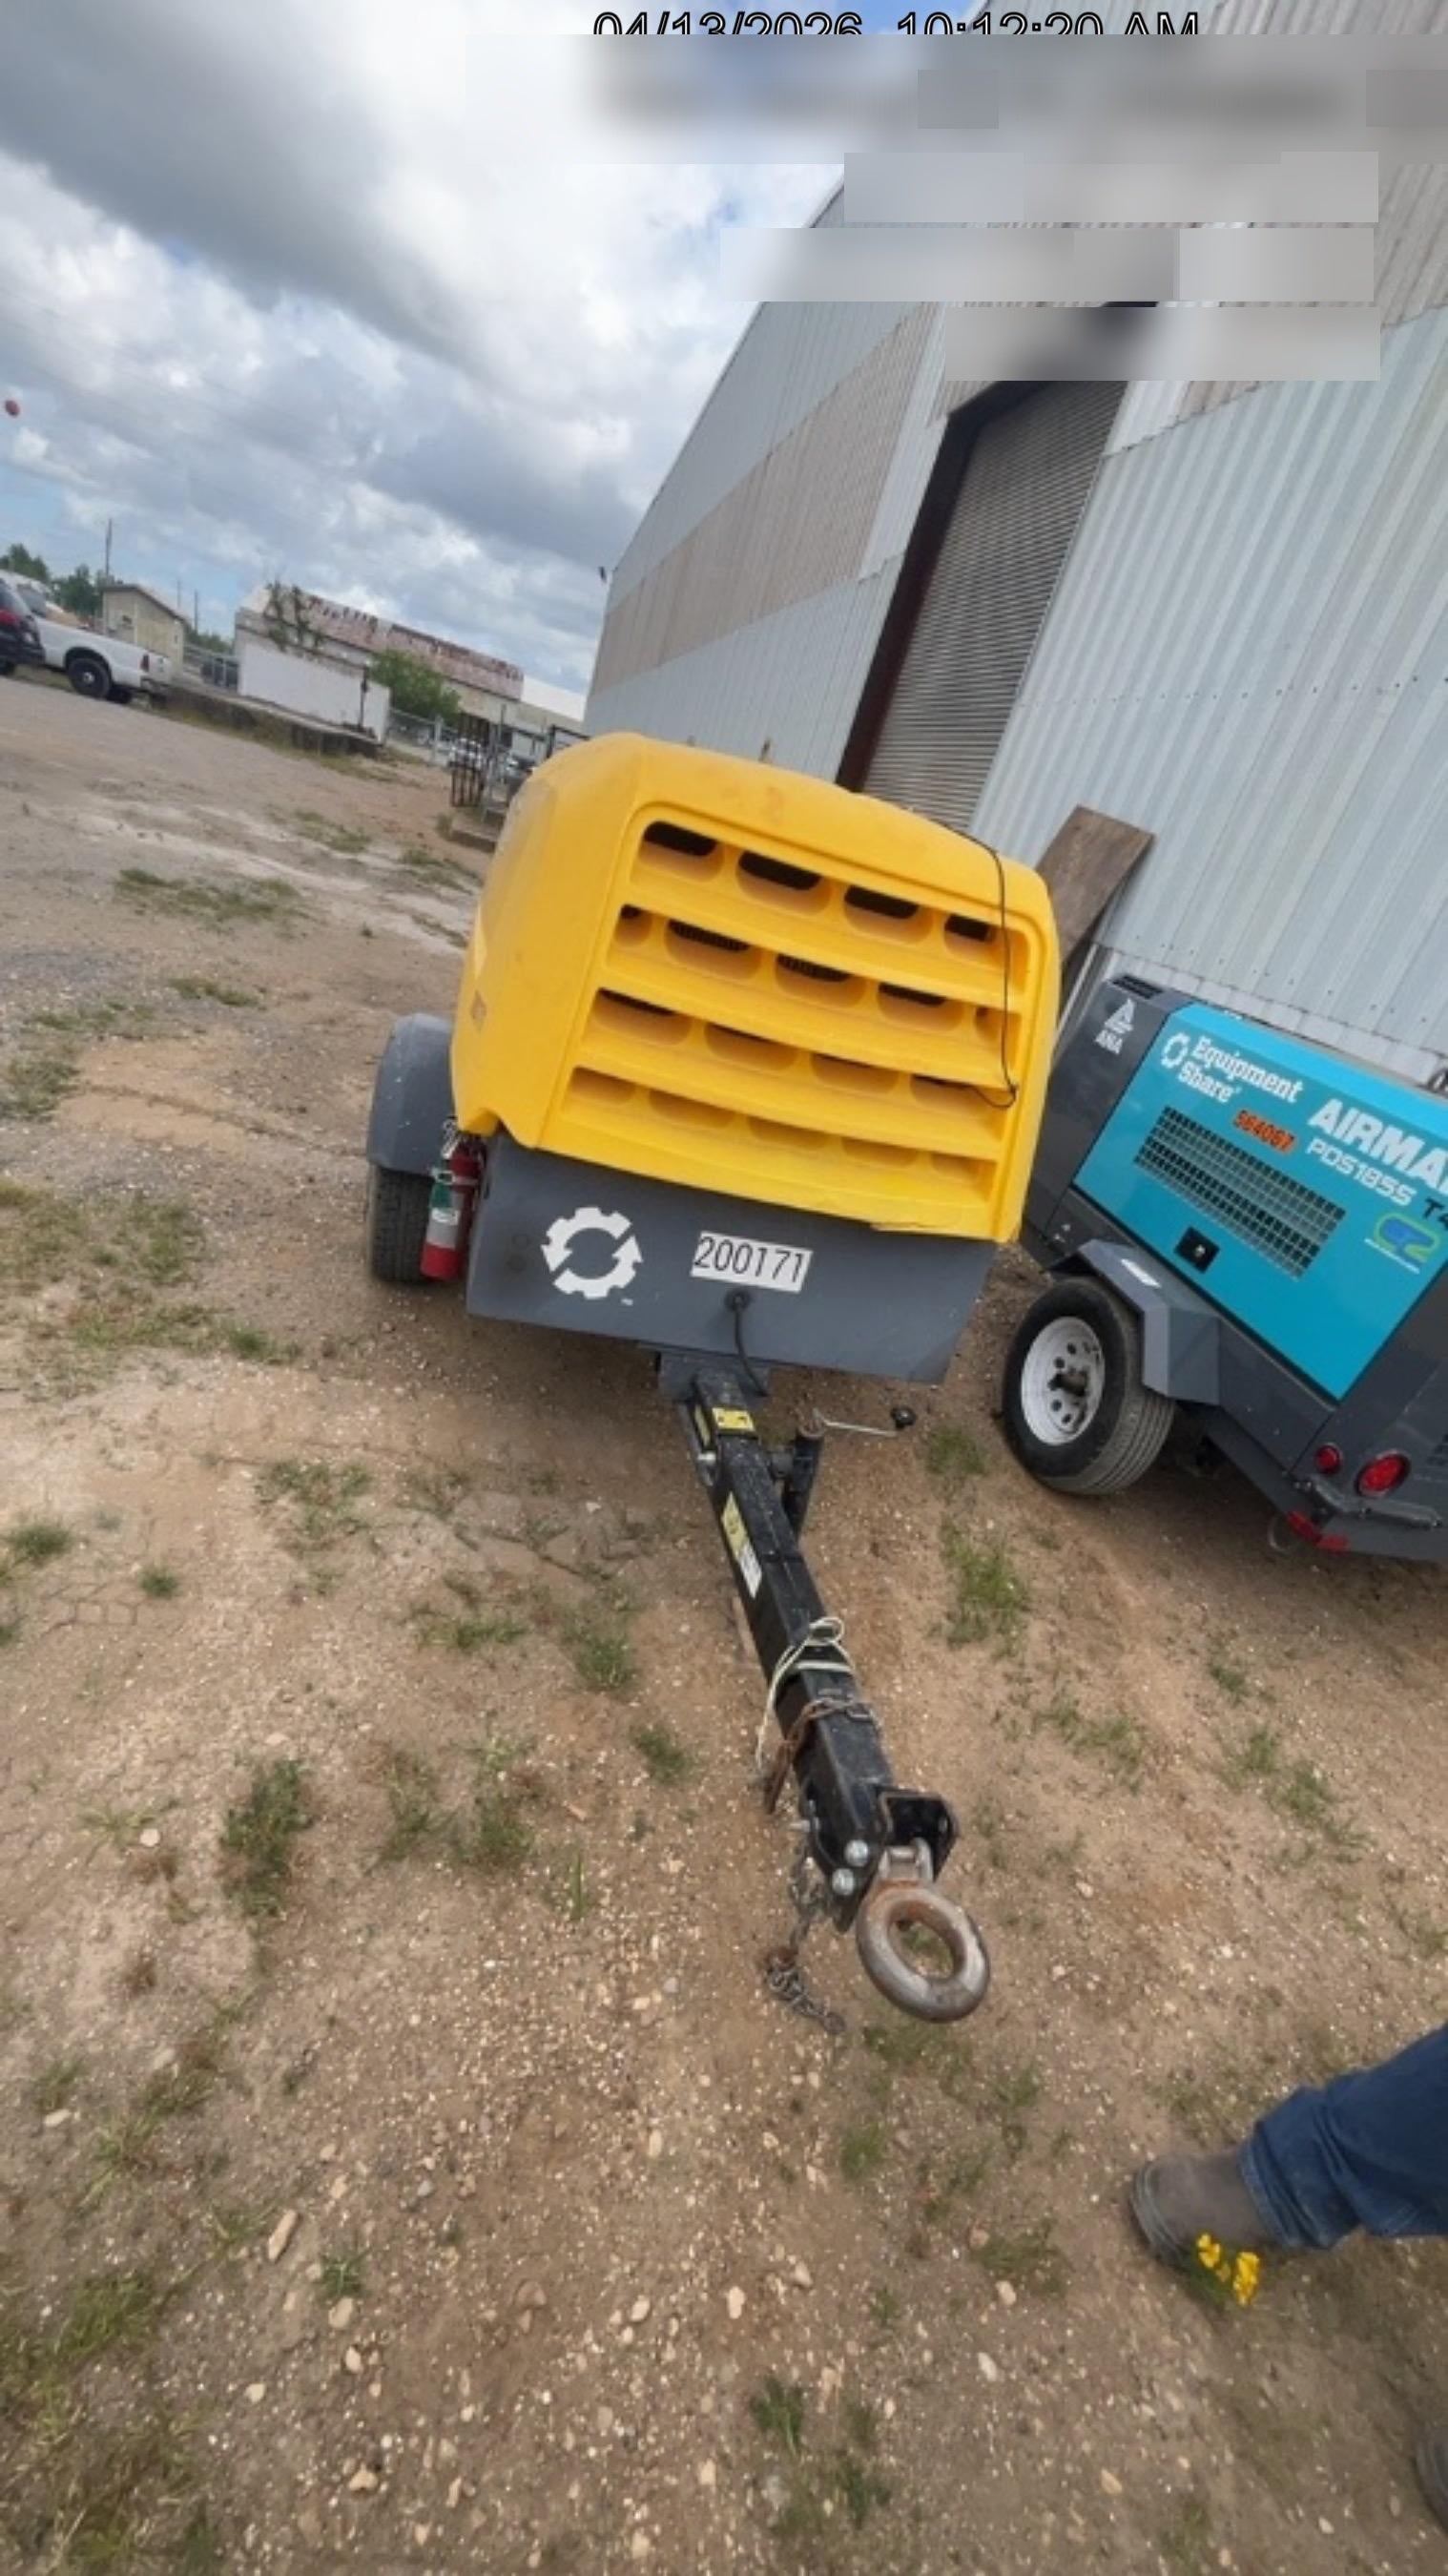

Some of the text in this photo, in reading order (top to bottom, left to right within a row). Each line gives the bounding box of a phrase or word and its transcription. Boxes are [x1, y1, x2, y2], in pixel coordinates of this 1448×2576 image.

[1178, 1061, 1234, 1103] Share
[1192, 1035, 1303, 1103] Equipment
[1308, 1098, 1448, 1195] AIRMA
[693, 1236, 803, 1282] 200171
